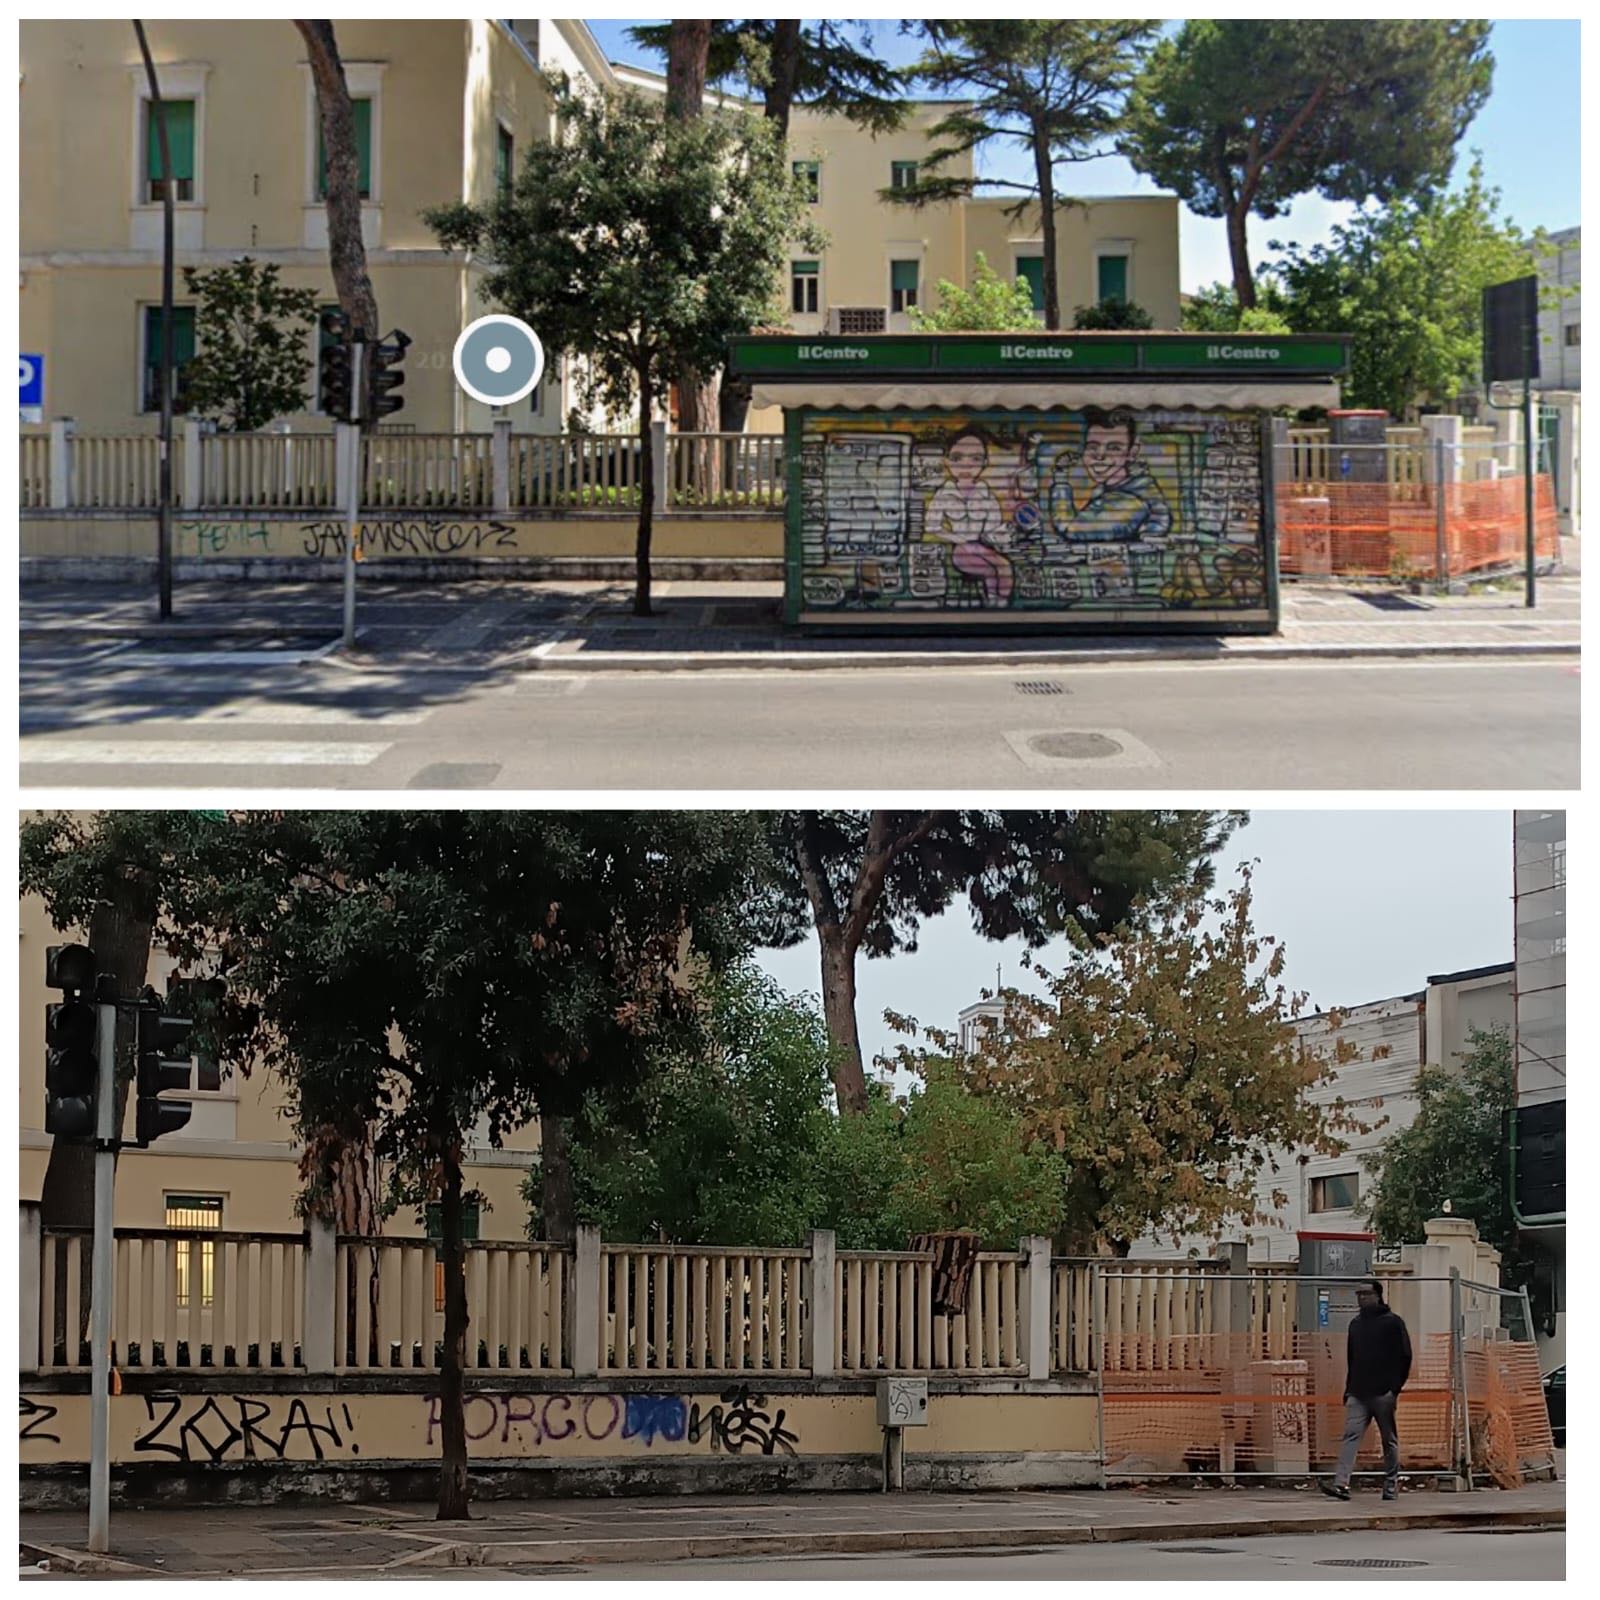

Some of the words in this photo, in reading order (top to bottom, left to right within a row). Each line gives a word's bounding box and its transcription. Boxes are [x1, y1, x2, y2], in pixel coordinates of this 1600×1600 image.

[798, 345, 810, 359] il
[811, 345, 869, 359] Centro
[1000, 345, 1012, 359] il
[1014, 345, 1073, 359] Centro
[1207, 345, 1219, 359] il
[1221, 345, 1280, 359] Centro
